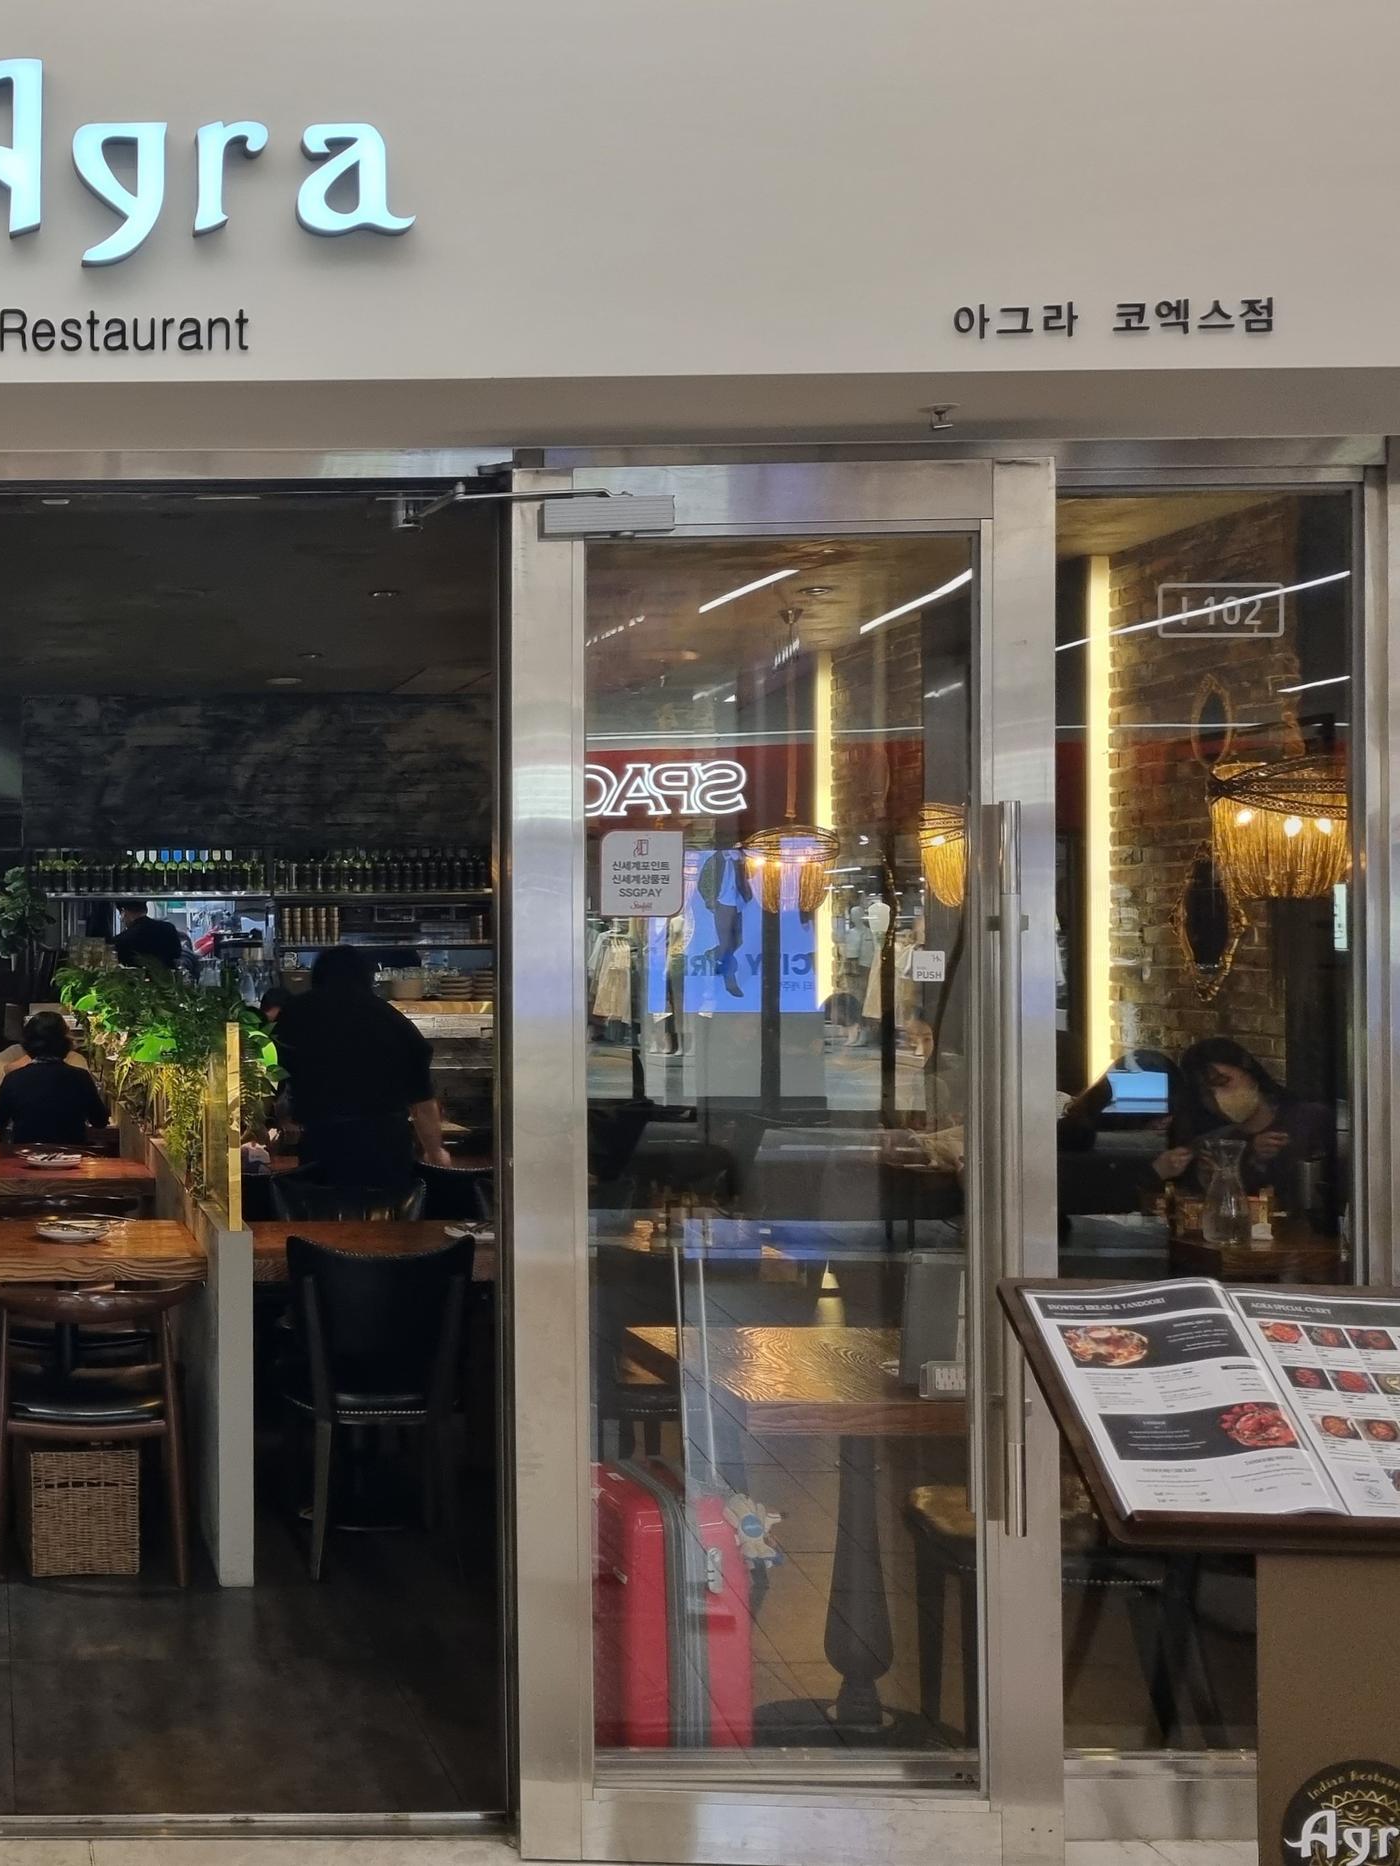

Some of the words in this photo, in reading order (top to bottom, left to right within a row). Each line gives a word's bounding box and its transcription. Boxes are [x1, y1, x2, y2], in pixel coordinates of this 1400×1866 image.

[953, 301, 1079, 340] 아그라
[1112, 296, 1274, 335] 코엑스점
[0, 308, 249, 353] Restaurant
[1204, 595, 1262, 626] 102
[611, 860, 671, 872] 신세계포인트
[611, 874, 670, 885] 신세계상품권
[618, 887, 663, 898] SSGPAY
[916, 970, 942, 979] PUSH
